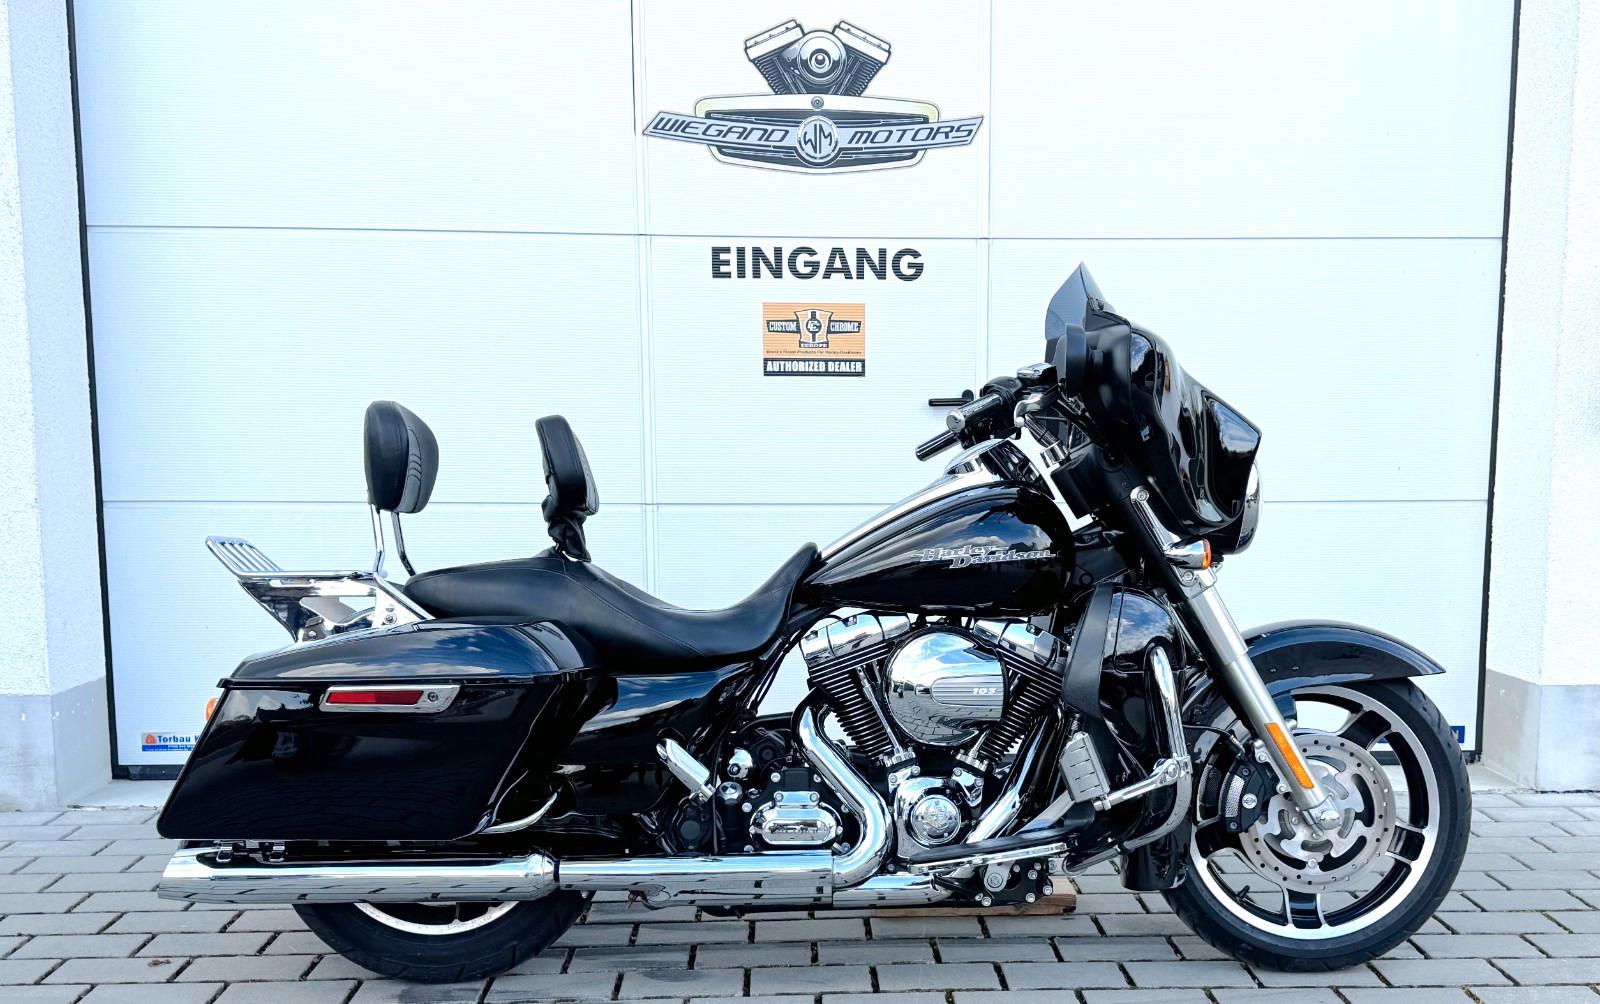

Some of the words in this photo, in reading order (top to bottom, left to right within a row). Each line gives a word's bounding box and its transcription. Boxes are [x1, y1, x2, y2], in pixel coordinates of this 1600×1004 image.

[652, 117, 789, 142] WIEGAND
[847, 123, 974, 145] MOTORS
[711, 246, 924, 281] EINGANG
[769, 321, 797, 332] CUSTOM
[830, 321, 859, 332] CHROME
[766, 361, 826, 372] AUTHORIZED
[828, 361, 862, 372] DEALER
[157, 735, 191, 743] Torbau
